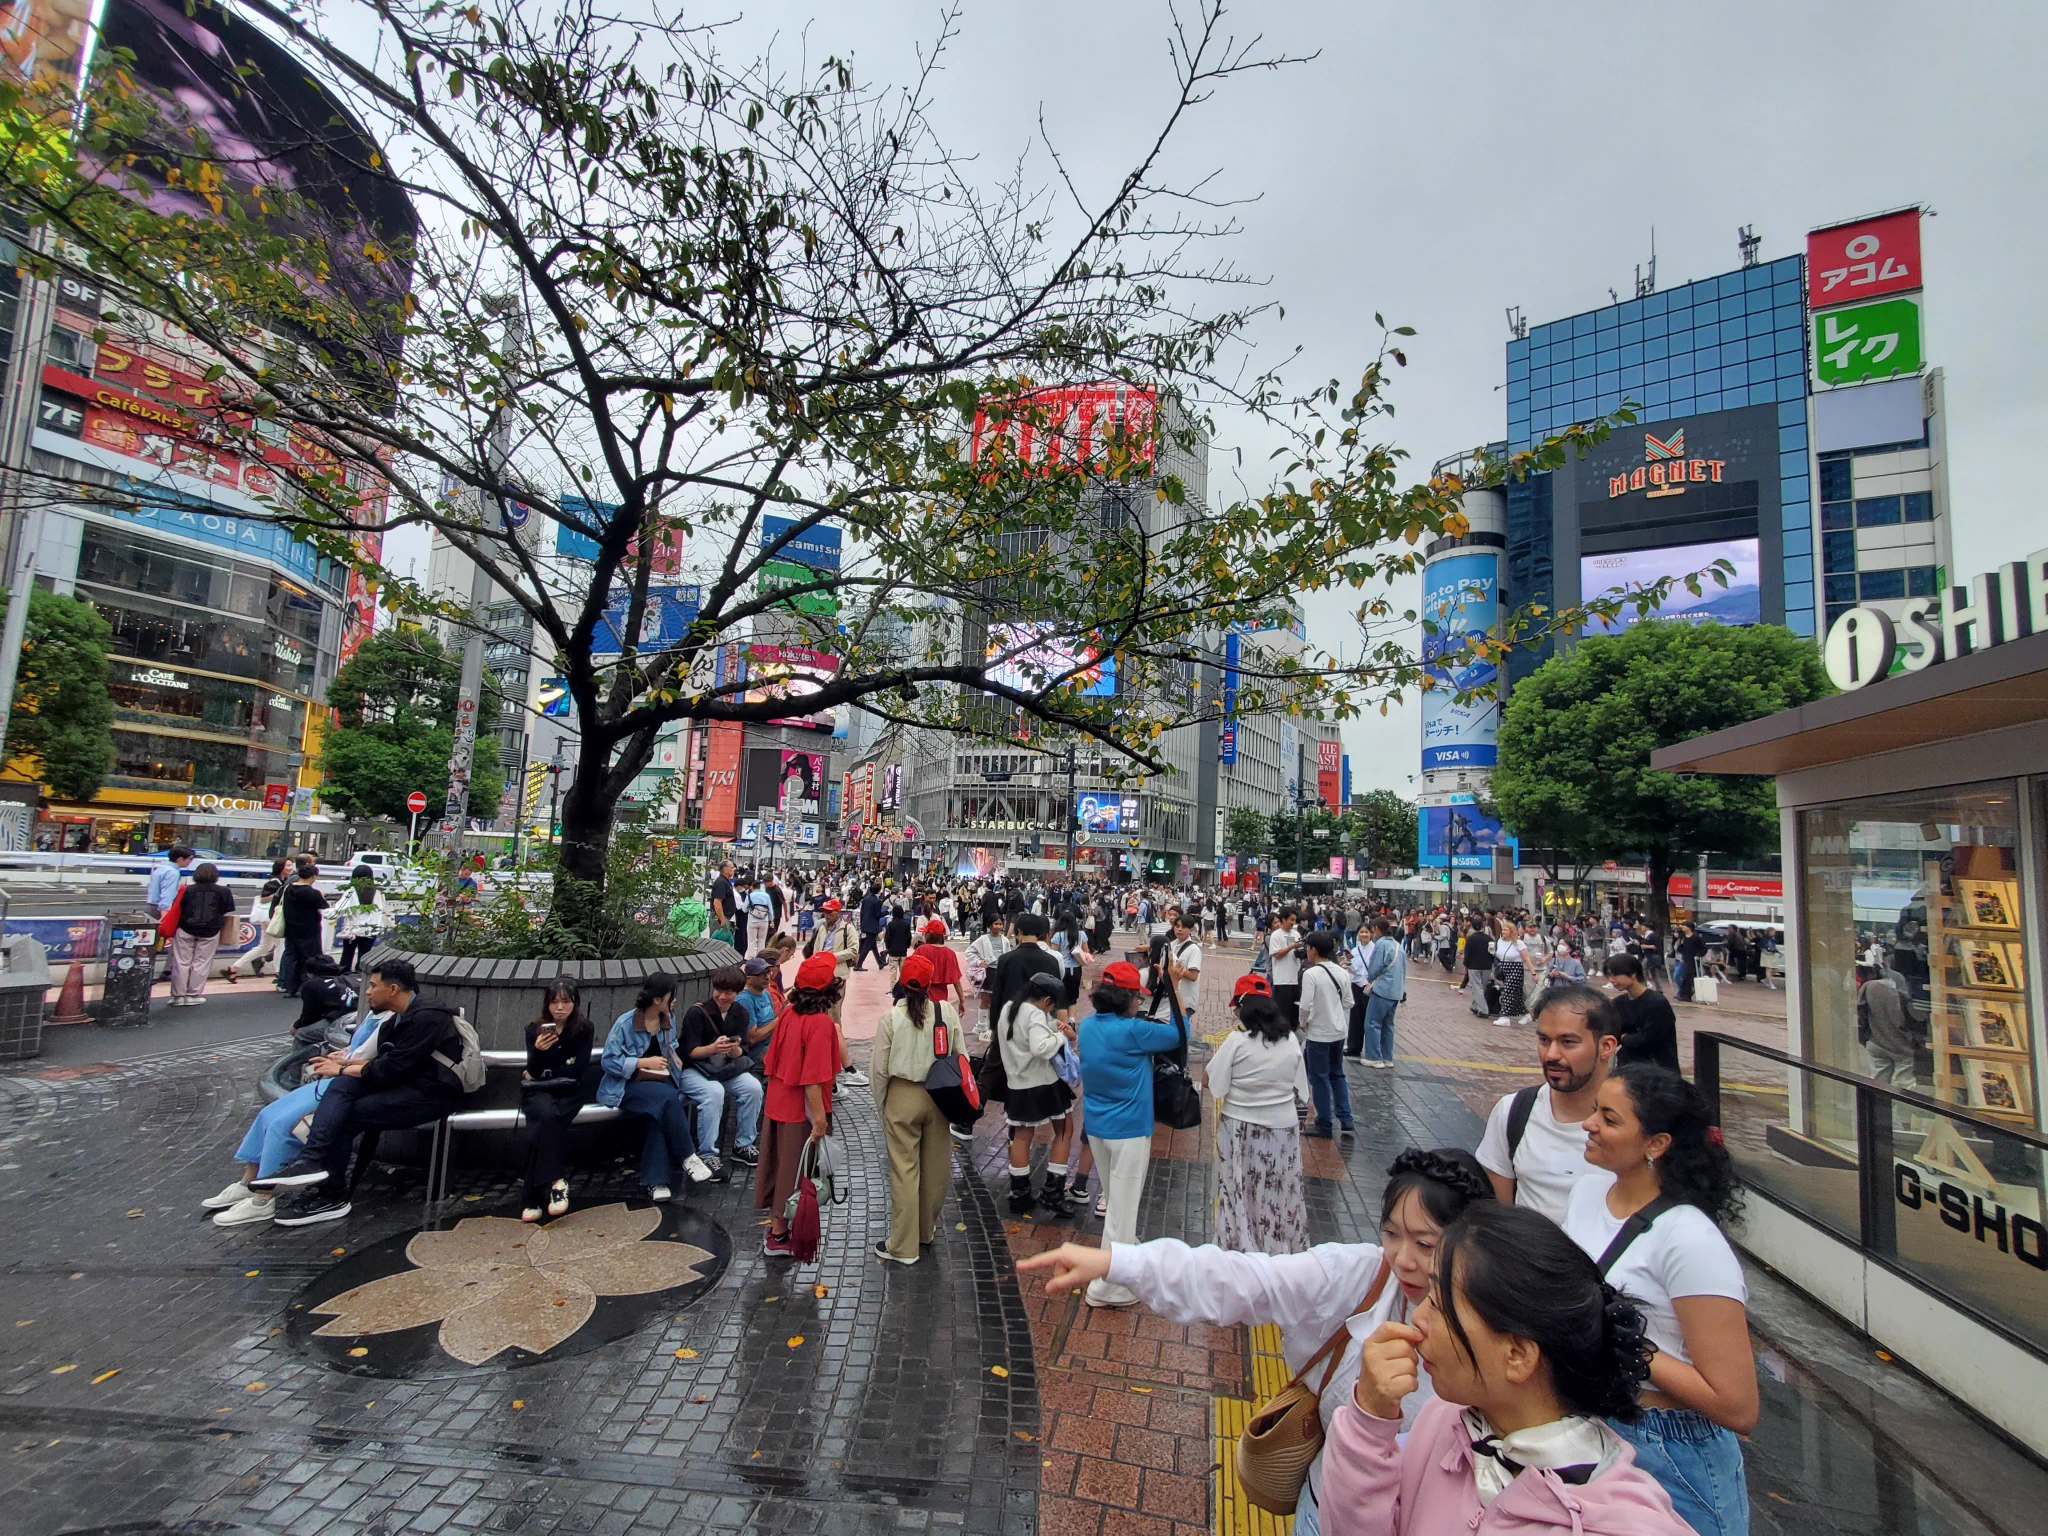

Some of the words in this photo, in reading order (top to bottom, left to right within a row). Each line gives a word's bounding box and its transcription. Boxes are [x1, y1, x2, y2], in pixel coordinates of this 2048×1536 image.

[1819, 257, 1909, 292] アコム
[62, 279, 98, 302] 9F
[1822, 316, 1899, 369] レイク
[41, 401, 83, 427] 7F
[138, 434, 232, 479] ガスト
[1608, 459, 1726, 498] MAGNET
[178, 511, 257, 542] AOBA
[276, 535, 315, 571] CLINC
[1438, 584, 1454, 596] to
[1457, 577, 1494, 591] Pay
[274, 642, 302, 665] Ushi8
[131, 673, 190, 690] L'OCCITANE
[1223, 721, 1234, 757] SEIBU
[1318, 755, 1338, 766] AST
[1435, 750, 1460, 762] VISA
[1707, 884, 1727, 894] ozy
[1726, 881, 1760, 893] Corner
[1894, 1162, 2048, 1272] G-SHO
